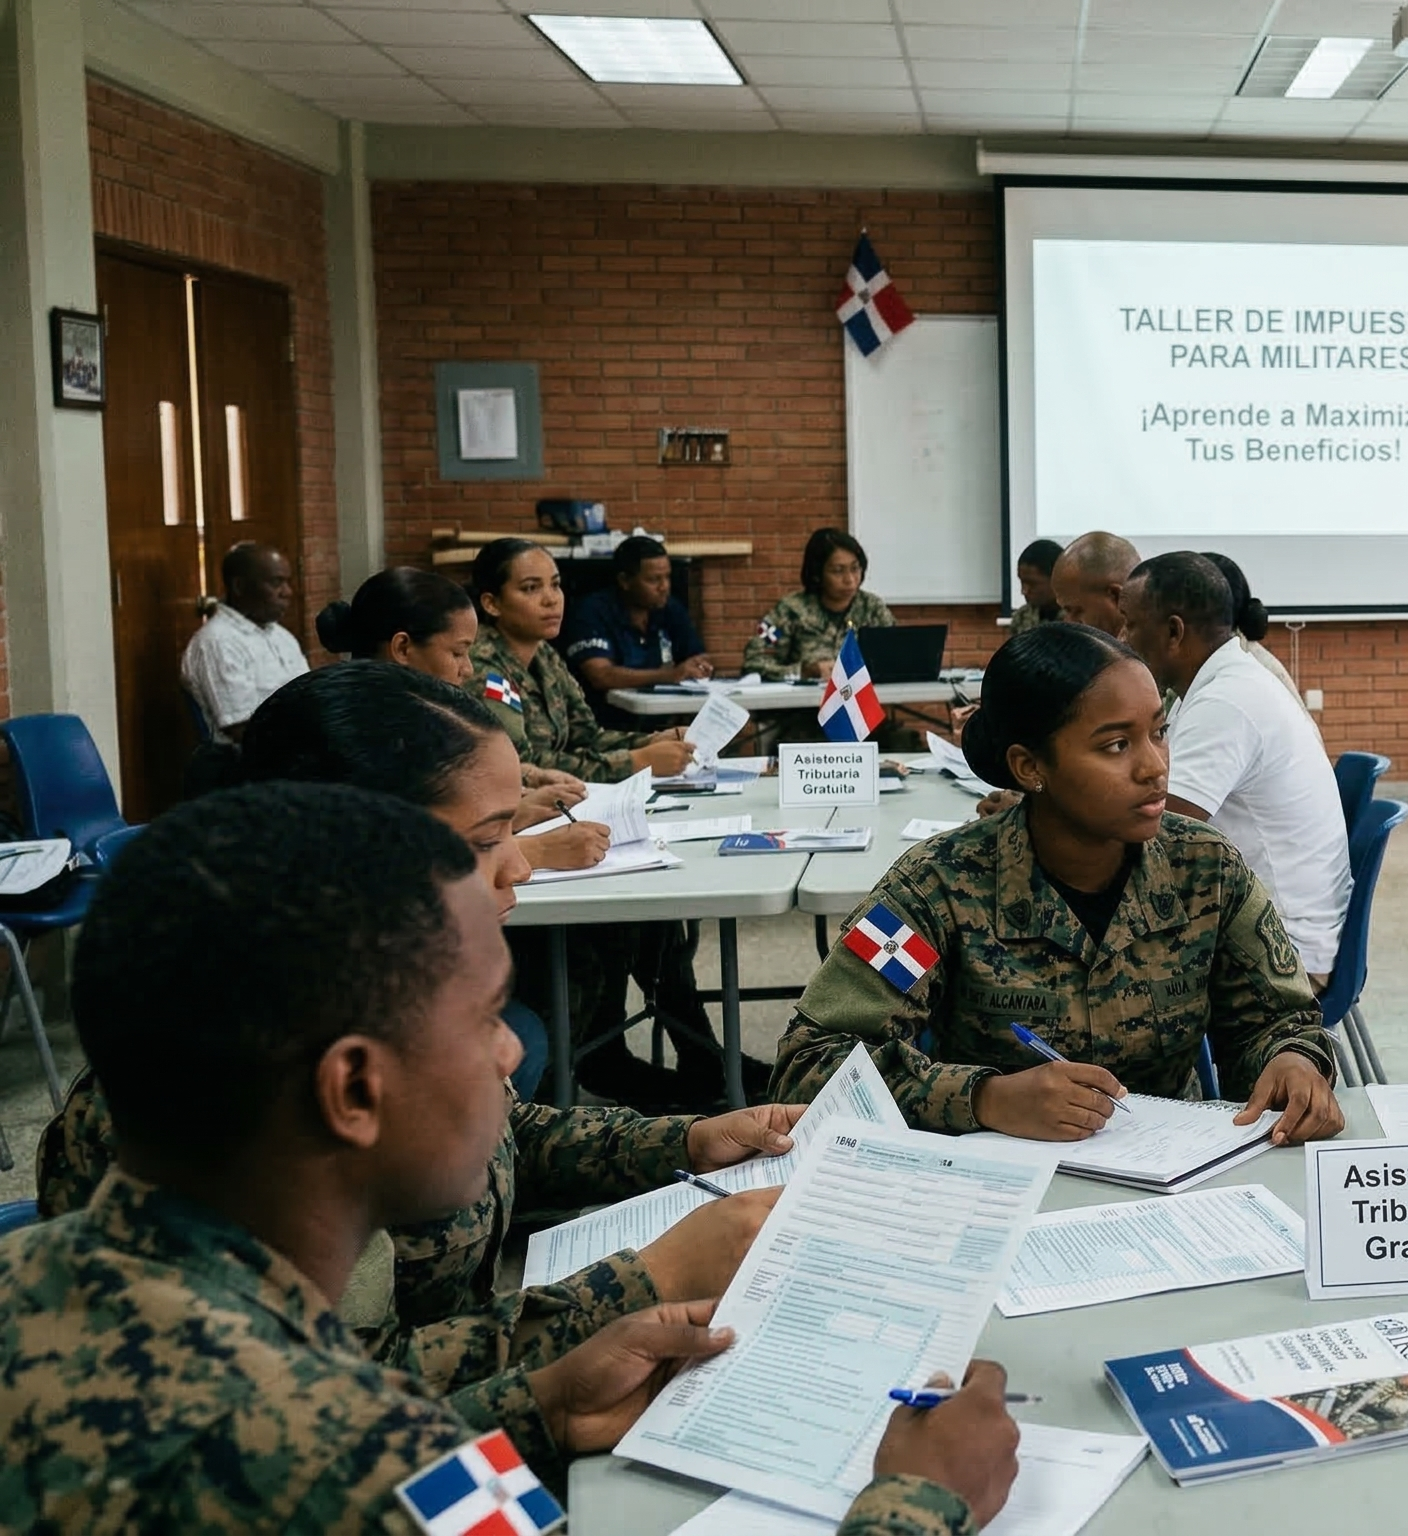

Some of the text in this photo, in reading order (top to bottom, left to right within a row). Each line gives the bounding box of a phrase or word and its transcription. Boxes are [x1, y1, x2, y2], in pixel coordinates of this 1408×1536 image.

[1119, 308, 1234, 333] TALLER
[1245, 309, 1283, 333] DE
[1171, 345, 1251, 369] PARA
[1142, 403, 1270, 432] ¡Aprende
[1280, 409, 1295, 427] a
[1185, 438, 1401, 463] Tus Beneficios!
[794, 753, 863, 765] Asistencia
[798, 768, 860, 780] Tributaria
[802, 783, 855, 795] Gratuita
